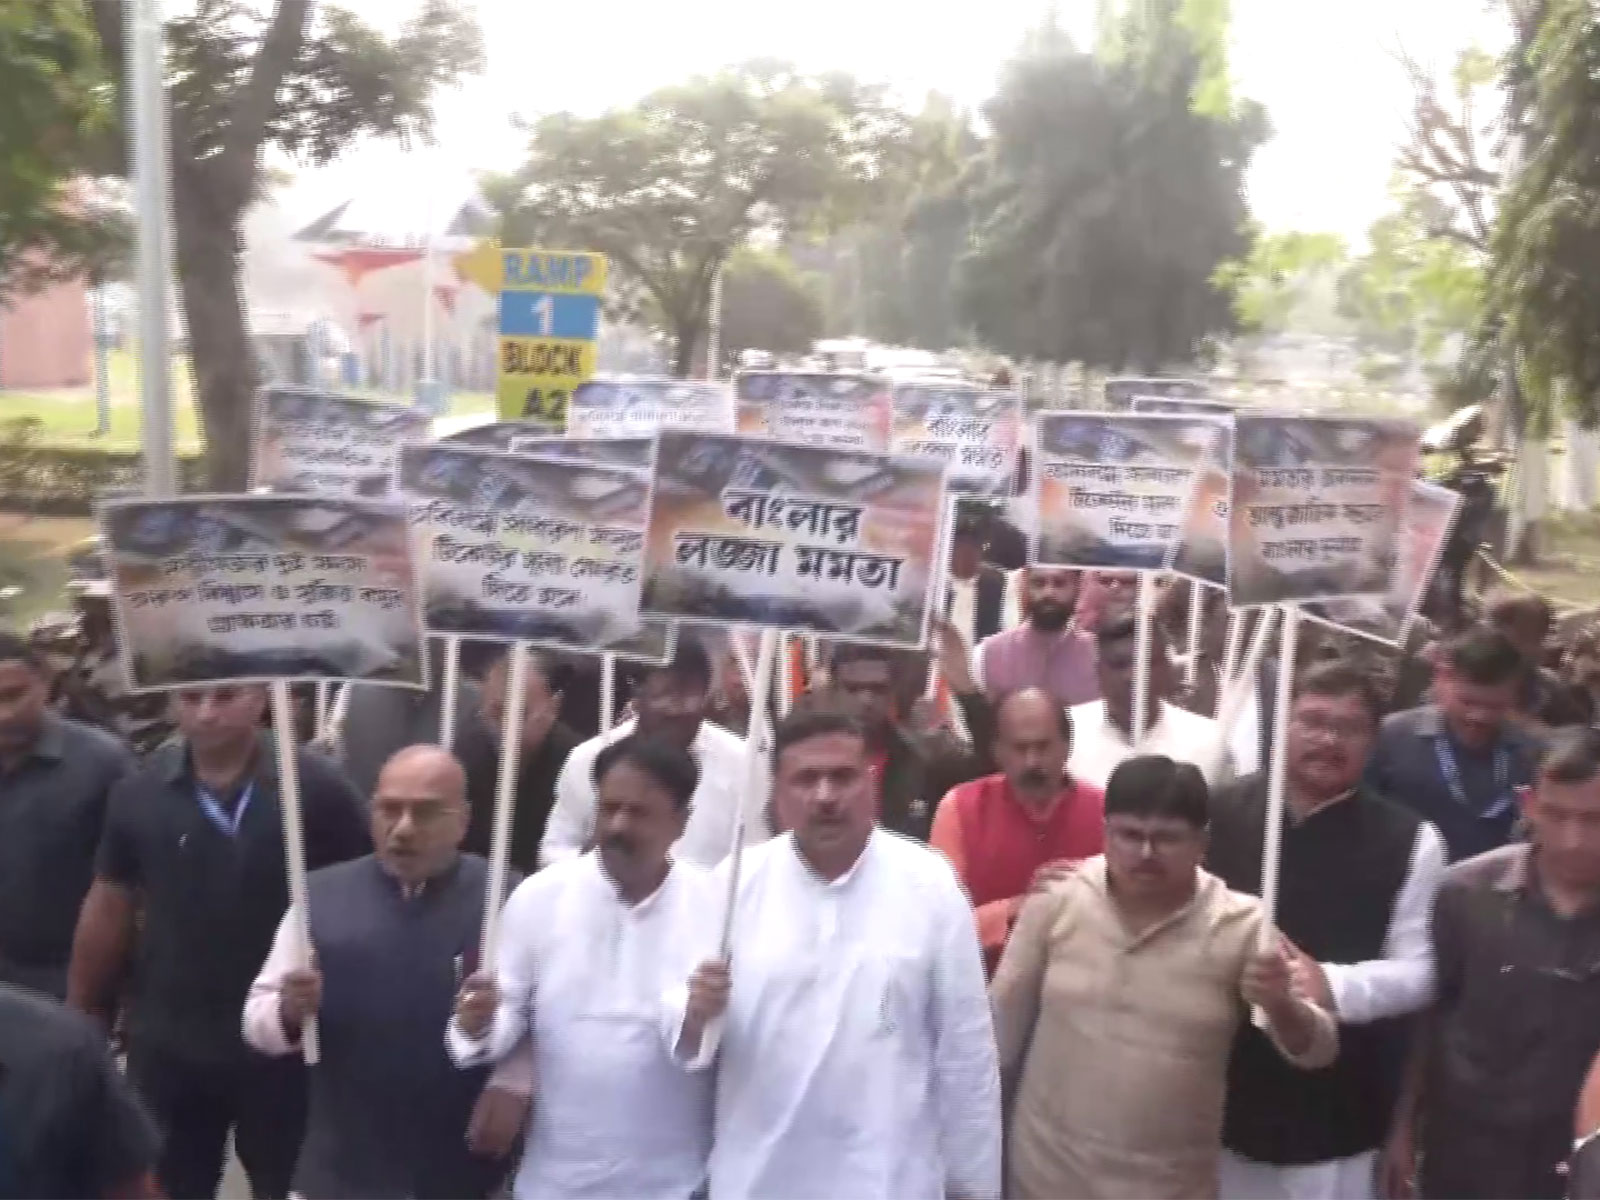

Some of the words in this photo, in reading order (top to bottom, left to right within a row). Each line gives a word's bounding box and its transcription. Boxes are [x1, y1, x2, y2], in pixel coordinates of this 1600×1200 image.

[503, 255, 593, 287] RAMP
[530, 295, 554, 336] 1
[502, 342, 582, 375] BLOCK
[521, 388, 566, 421] A2
[925, 418, 992, 441] বাংলার
[723, 493, 864, 545] বাংলার
[675, 535, 783, 578] লজ্জা
[796, 548, 904, 593] মমতা
[271, 585, 291, 603] ও
